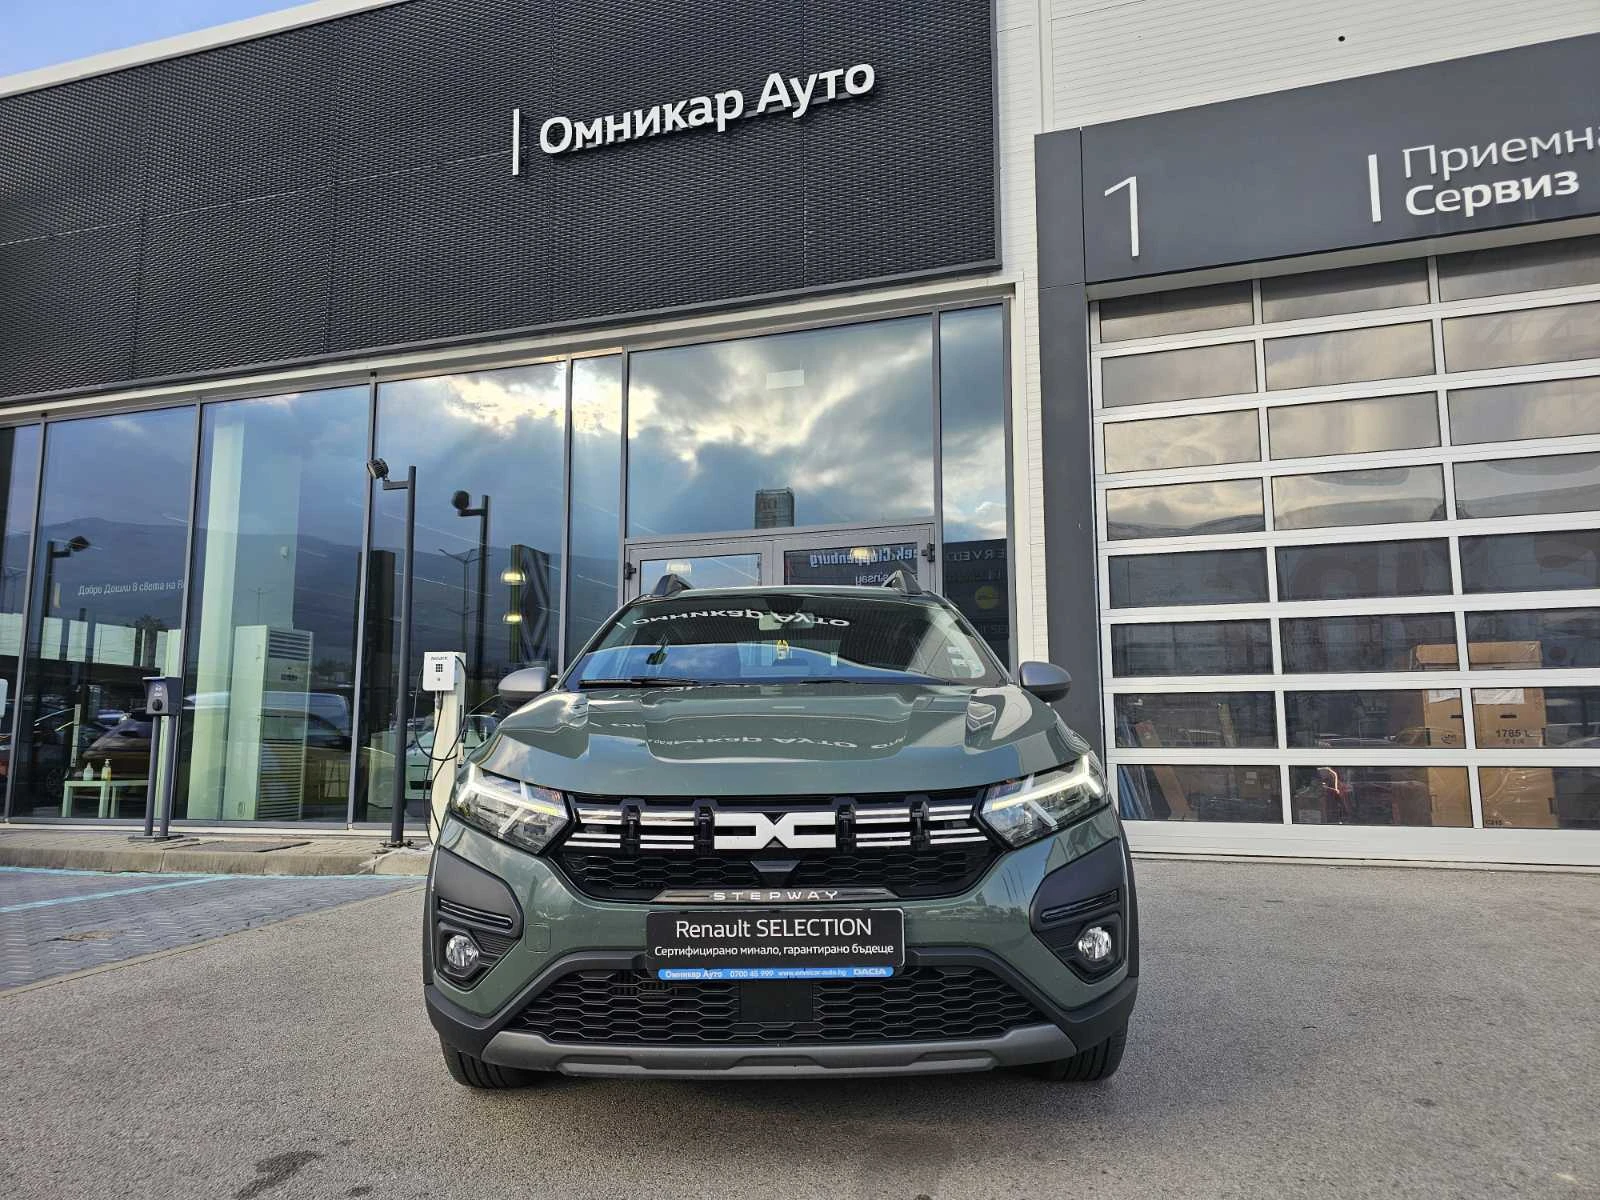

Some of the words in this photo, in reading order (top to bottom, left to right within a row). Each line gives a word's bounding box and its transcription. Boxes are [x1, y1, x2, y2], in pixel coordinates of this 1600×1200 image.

[539, 88, 744, 154] Омникар
[757, 63, 876, 119] Ауто
[1402, 126, 1600, 182] Приемн
[1405, 170, 1580, 218] Сервиз
[1104, 175, 1140, 258] 1
[713, 890, 838, 901] STEPWAY
[675, 919, 751, 939] Renault
[756, 918, 872, 937] SELECTION
[654, 945, 738, 958] Сертифицирано
[739, 946, 782, 957] минало,
[783, 945, 850, 957] гарантирано
[851, 943, 894, 955] бъдеще
[853, 967, 887, 976] DACIA
